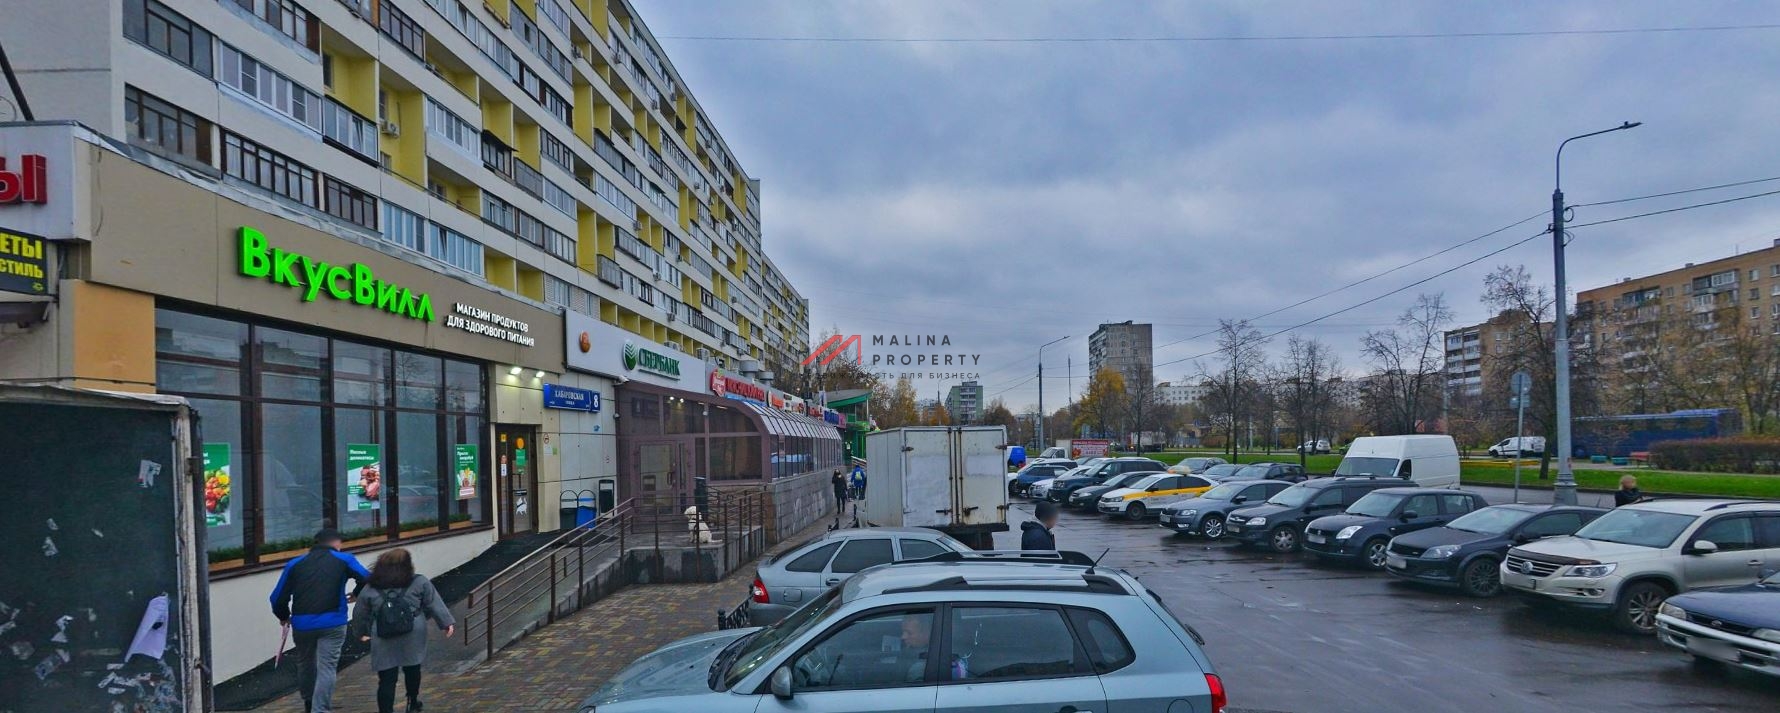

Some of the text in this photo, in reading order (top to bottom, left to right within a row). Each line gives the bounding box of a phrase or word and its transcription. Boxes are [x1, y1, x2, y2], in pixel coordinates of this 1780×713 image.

[447, 314, 535, 347] ДЛЯ ЗДОРОВОГО ПИТАНИЯ
[456, 302, 529, 332] МАГАЗИН ПРОДУКТОВ
[639, 348, 680, 376] СБЕРБАНК
[593, 394, 599, 408] 8
